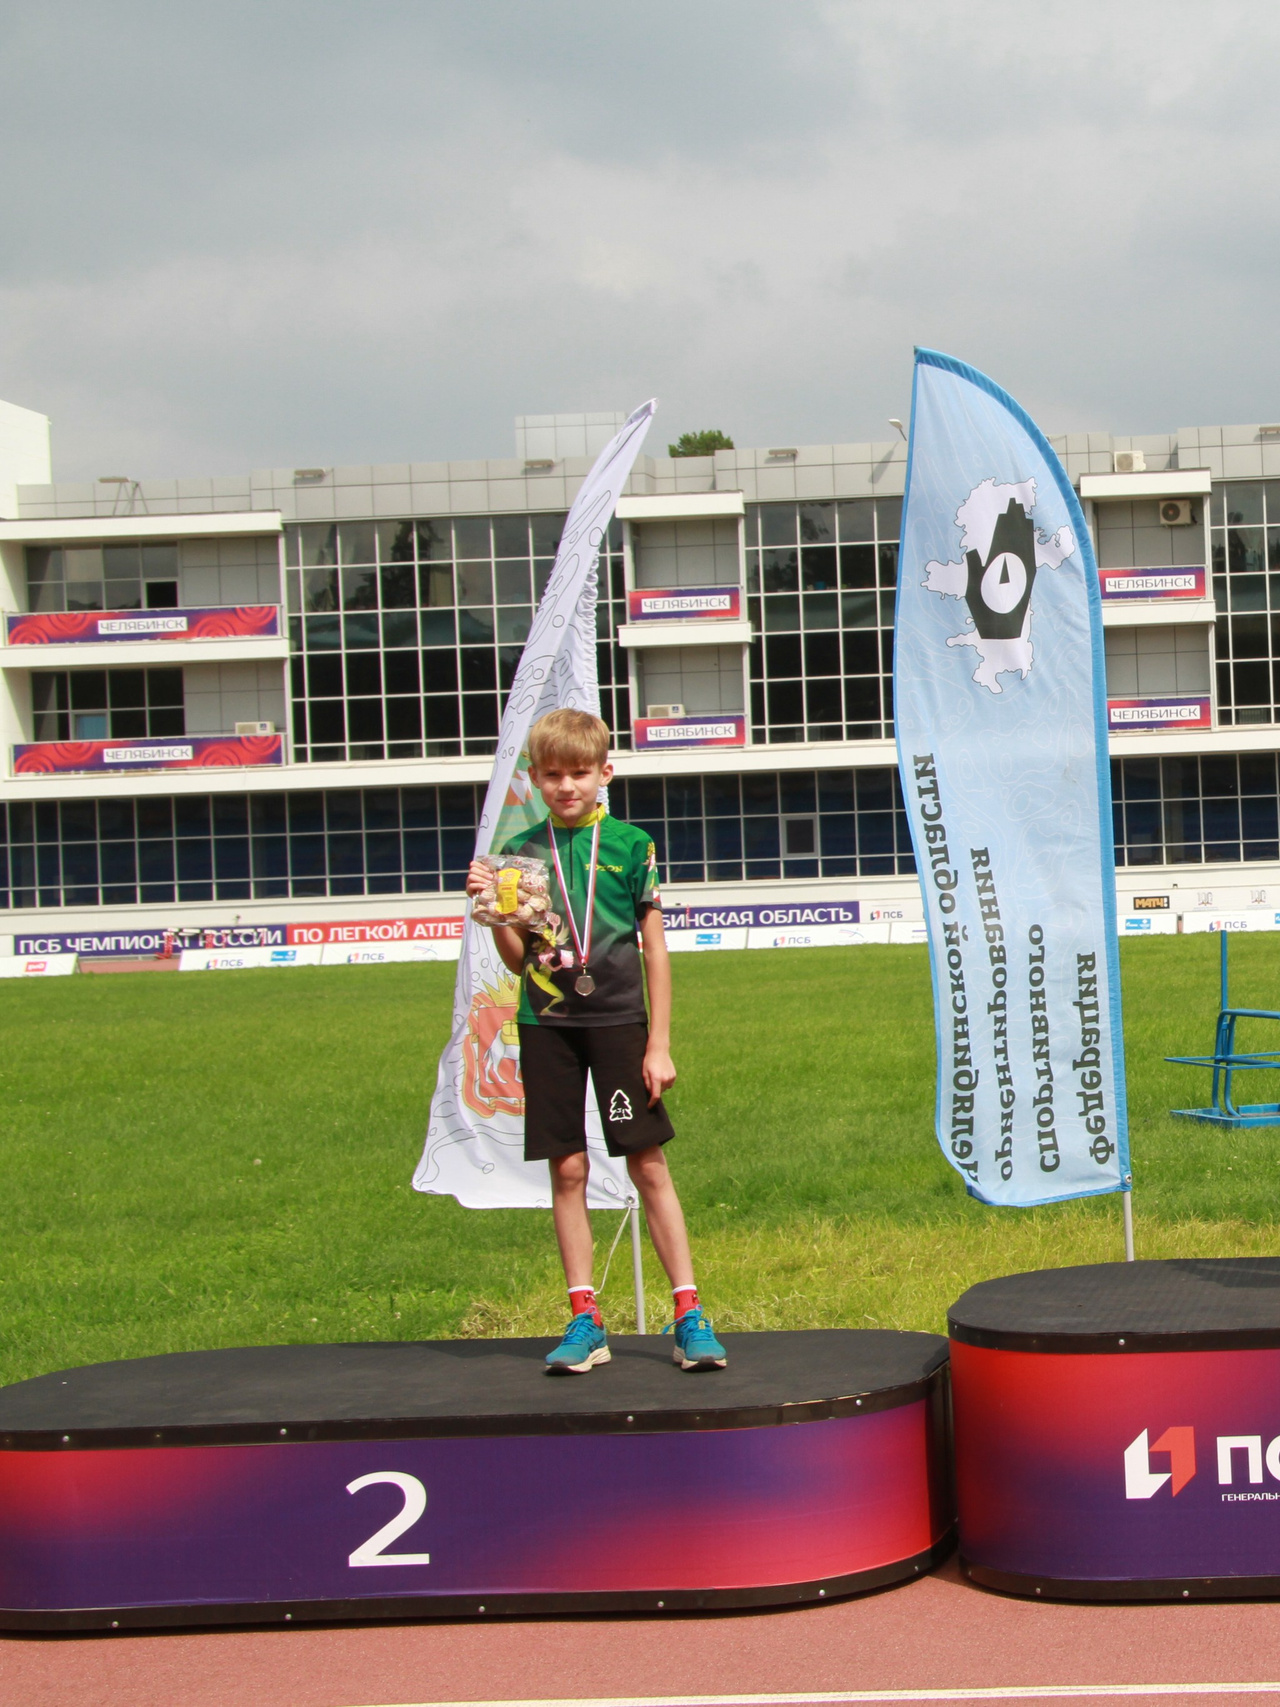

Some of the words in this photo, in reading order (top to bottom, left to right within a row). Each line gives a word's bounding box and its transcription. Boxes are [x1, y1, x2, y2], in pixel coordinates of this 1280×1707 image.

[1107, 577, 1193, 589] ЧЕЛЯБИНСК
[643, 597, 727, 610] ЧЕЛЯБИНСК
[99, 618, 186, 632] ЧЕЛЯБИНСК
[1112, 707, 1198, 720] ЧЕЛЯБИНСК
[649, 725, 733, 738] ЧЕЛЯБИНСК
[105, 747, 190, 760] ЧЕЛЯБИНСК
[662, 911, 754, 928] БИНСКАЯ
[759, 907, 853, 924] ОБЛАСТЬ
[883, 911, 903, 919] ПСБ
[1224, 921, 1247, 929] ПСБ
[294, 928, 323, 943] ПО
[328, 922, 408, 942] ЛЕГКОЙ
[413, 922, 463, 938] АТЛЕ
[19, 939, 61, 954] ПСБ
[788, 936, 811, 945] ПСБ
[221, 959, 243, 967] ПСБ
[362, 952, 385, 961] ПСБ
[346, 1470, 430, 1567] 2
